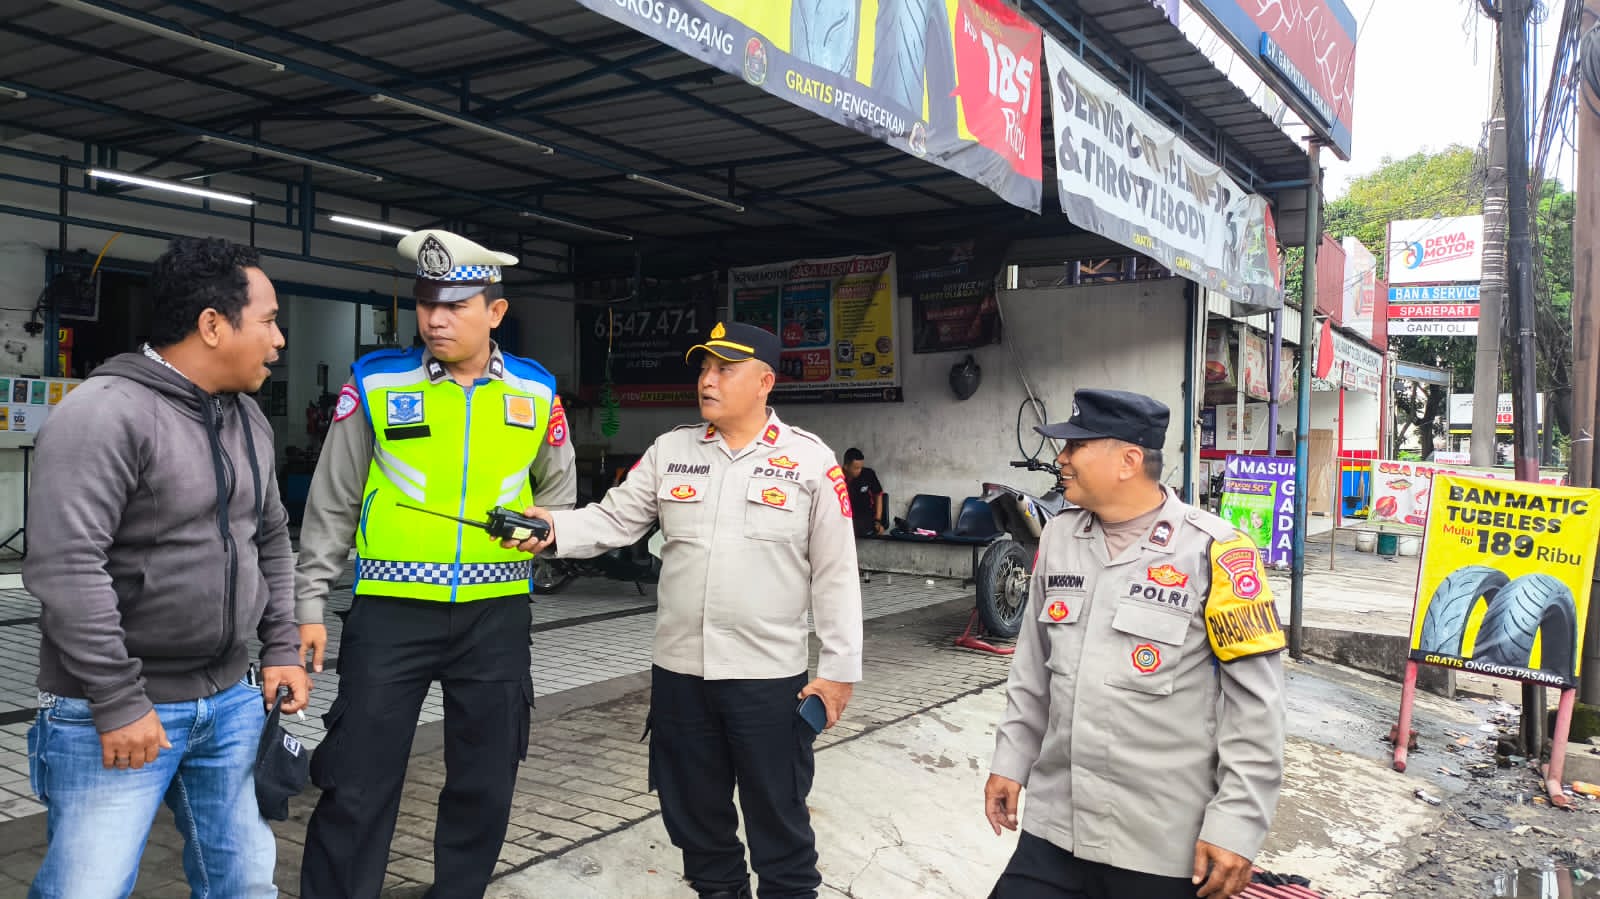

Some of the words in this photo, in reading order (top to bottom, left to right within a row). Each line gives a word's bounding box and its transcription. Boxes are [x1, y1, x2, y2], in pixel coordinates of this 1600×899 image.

[667, 7, 733, 55] PASANG
[785, 69, 833, 104] GRATIS
[834, 88, 905, 136] PENGECEKAN
[1425, 232, 1466, 248] DEWA
[1424, 240, 1475, 259] MOTOR
[1396, 288, 1419, 299] BAN
[1400, 305, 1473, 316] SPAREPART
[1407, 324, 1443, 333] GANTI
[1447, 324, 1465, 333] OLI
[667, 462, 710, 475] RUSANDI
[753, 466, 800, 481] POLRI
[1378, 463, 1411, 477] SEA
[1449, 485, 1500, 506] BAN
[1505, 492, 1588, 515] MATIC
[1446, 505, 1562, 534] TUBELESS
[1443, 523, 1474, 537] Mulai
[1460, 536, 1473, 545] Rp
[1476, 529, 1535, 558] 189
[1537, 546, 1582, 566] Ribu
[1129, 583, 1189, 608] POLRI
[1425, 654, 1463, 669] GRATIS
[1464, 660, 1514, 676] ONGKOS
[1515, 669, 1565, 685] PASANG
